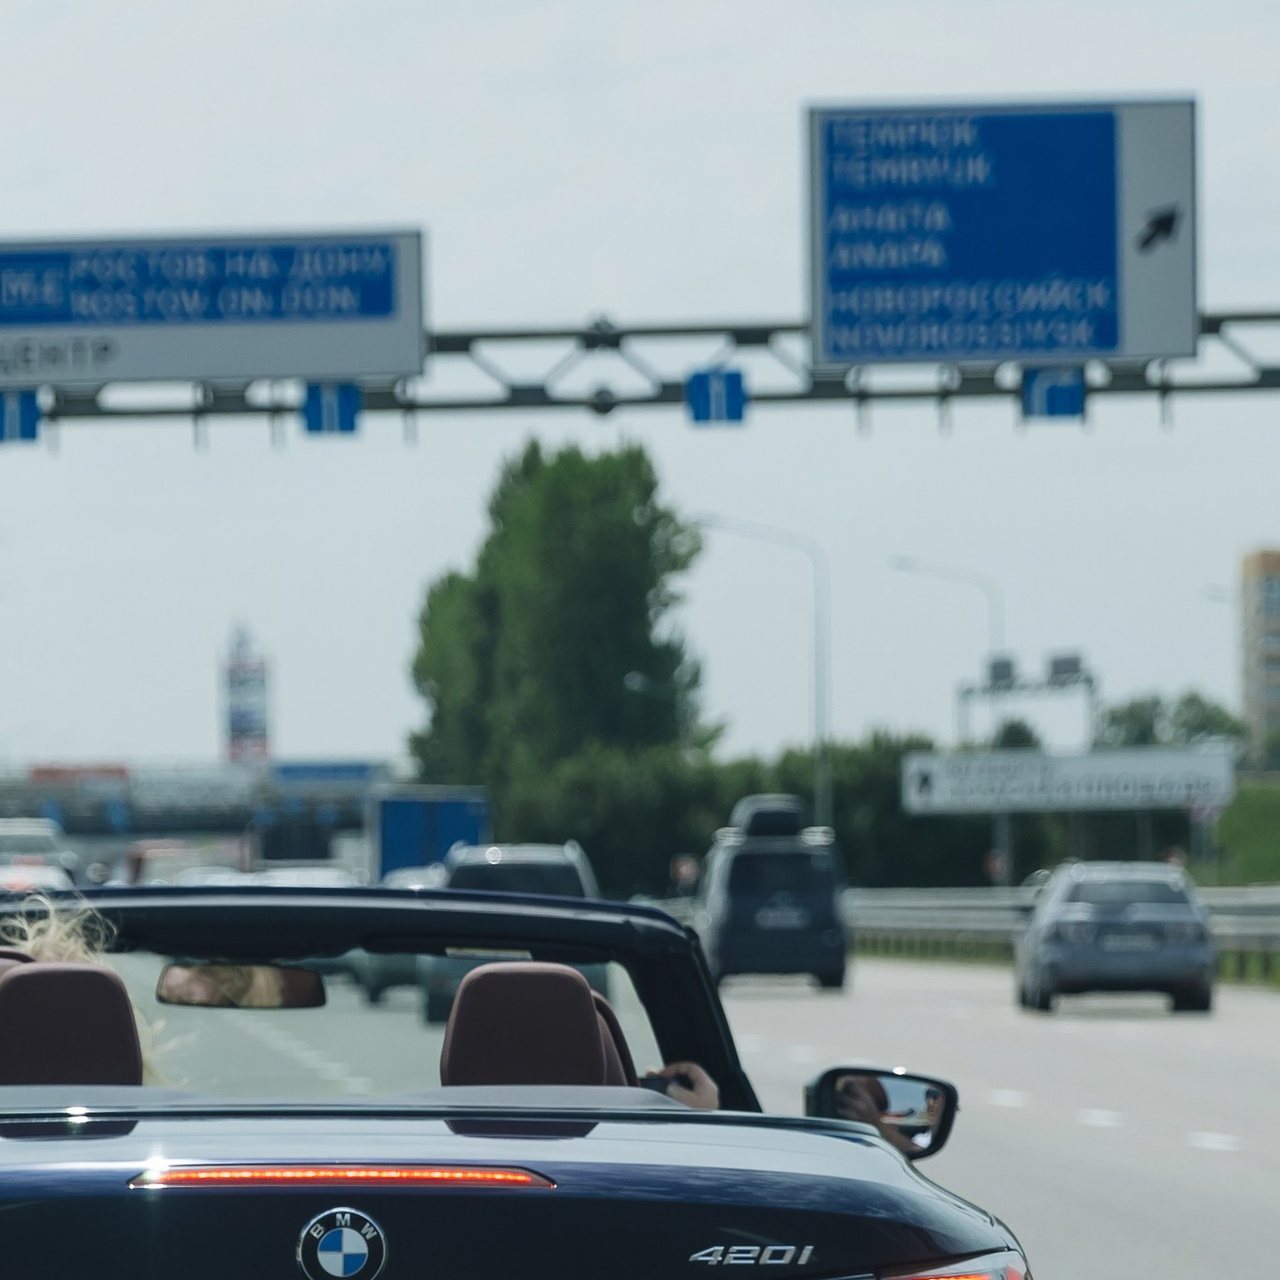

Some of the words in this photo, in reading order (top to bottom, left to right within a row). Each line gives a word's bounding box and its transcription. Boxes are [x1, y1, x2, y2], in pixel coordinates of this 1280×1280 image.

[831, 203, 951, 232] АНАПА
[831, 239, 946, 268] ANAPA
[309, 1212, 378, 1240] BMW
